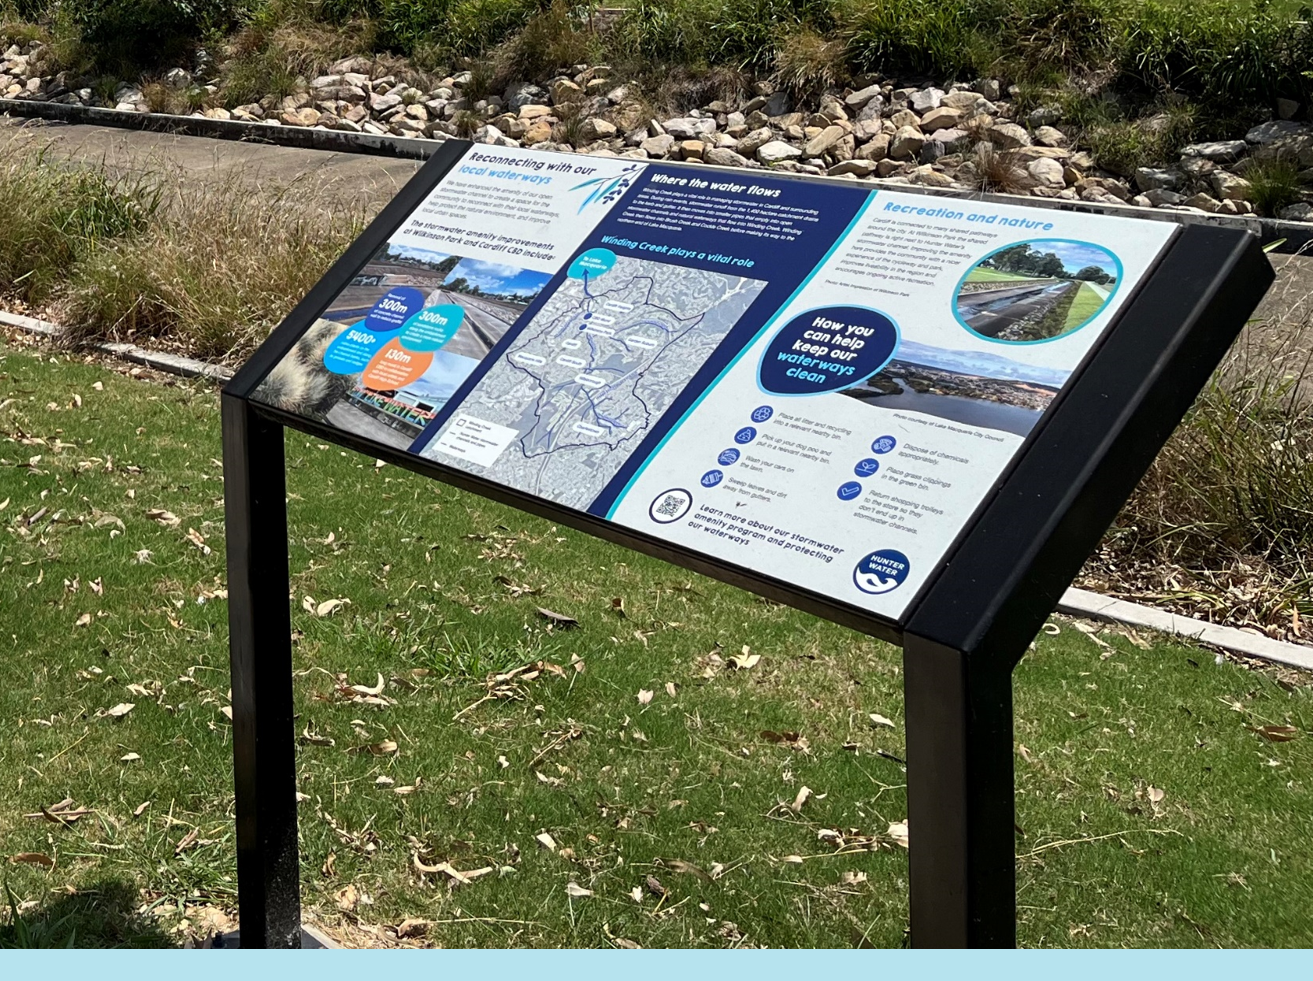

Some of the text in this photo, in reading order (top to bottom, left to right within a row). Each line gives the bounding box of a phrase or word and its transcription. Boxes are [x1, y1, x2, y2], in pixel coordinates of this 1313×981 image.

[469, 152, 597, 175] Reconnecting with our
[458, 165, 552, 185] local waterways
[651, 173, 781, 197] Where the water flows
[883, 202, 1054, 231] Recreation and nature
[411, 219, 555, 251] The stormwater amenity improvements
[412, 230, 445, 241] Wilkinson
[444, 235, 463, 244] Park
[478, 241, 508, 252] Cardiff
[507, 246, 523, 255] CBD
[601, 235, 639, 249] Winding
[639, 242, 669, 253] Creek
[667, 247, 697, 258] plays
[707, 253, 733, 264] vital
[731, 258, 755, 268] role
[378, 298, 408, 313] 300m
[418, 311, 448, 326] 300m
[812, 317, 875, 337] How you
[792, 339, 857, 361] keep our
[803, 330, 865, 350] can help
[385, 349, 411, 363] 130m
[777, 352, 855, 376] waterways
[786, 367, 826, 383] clean
[778, 412, 794, 420] Place
[826, 425, 852, 436] recycling
[789, 424, 812, 432] relevant
[811, 429, 831, 438] nearby
[761, 433, 774, 441] Pick
[795, 443, 808, 451] dog
[745, 455, 761, 463] Wash
[777, 446, 800, 456] relevant
[799, 452, 819, 462] nearby
[903, 443, 929, 454] Dispose
[937, 452, 969, 464] chemicals
[728, 477, 747, 487] Sweep
[747, 483, 765, 492] leaves
[886, 466, 951, 488] Place grass clippings
[898, 479, 917, 487] green
[722, 484, 738, 493] away
[858, 505, 876, 513] don't
[869, 489, 944, 515] Return shopping trolleys
[871, 499, 882, 507] the
[882, 503, 899, 511] store
[908, 510, 923, 519] they
[853, 512, 889, 525] stormwater
[688, 521, 750, 545] our waterways
[694, 513, 833, 563] amenity program and protecting
[700, 504, 844, 554] Learn more about our stormwater
[869, 562, 898, 576] WATER
[870, 555, 905, 570] HUNTER
